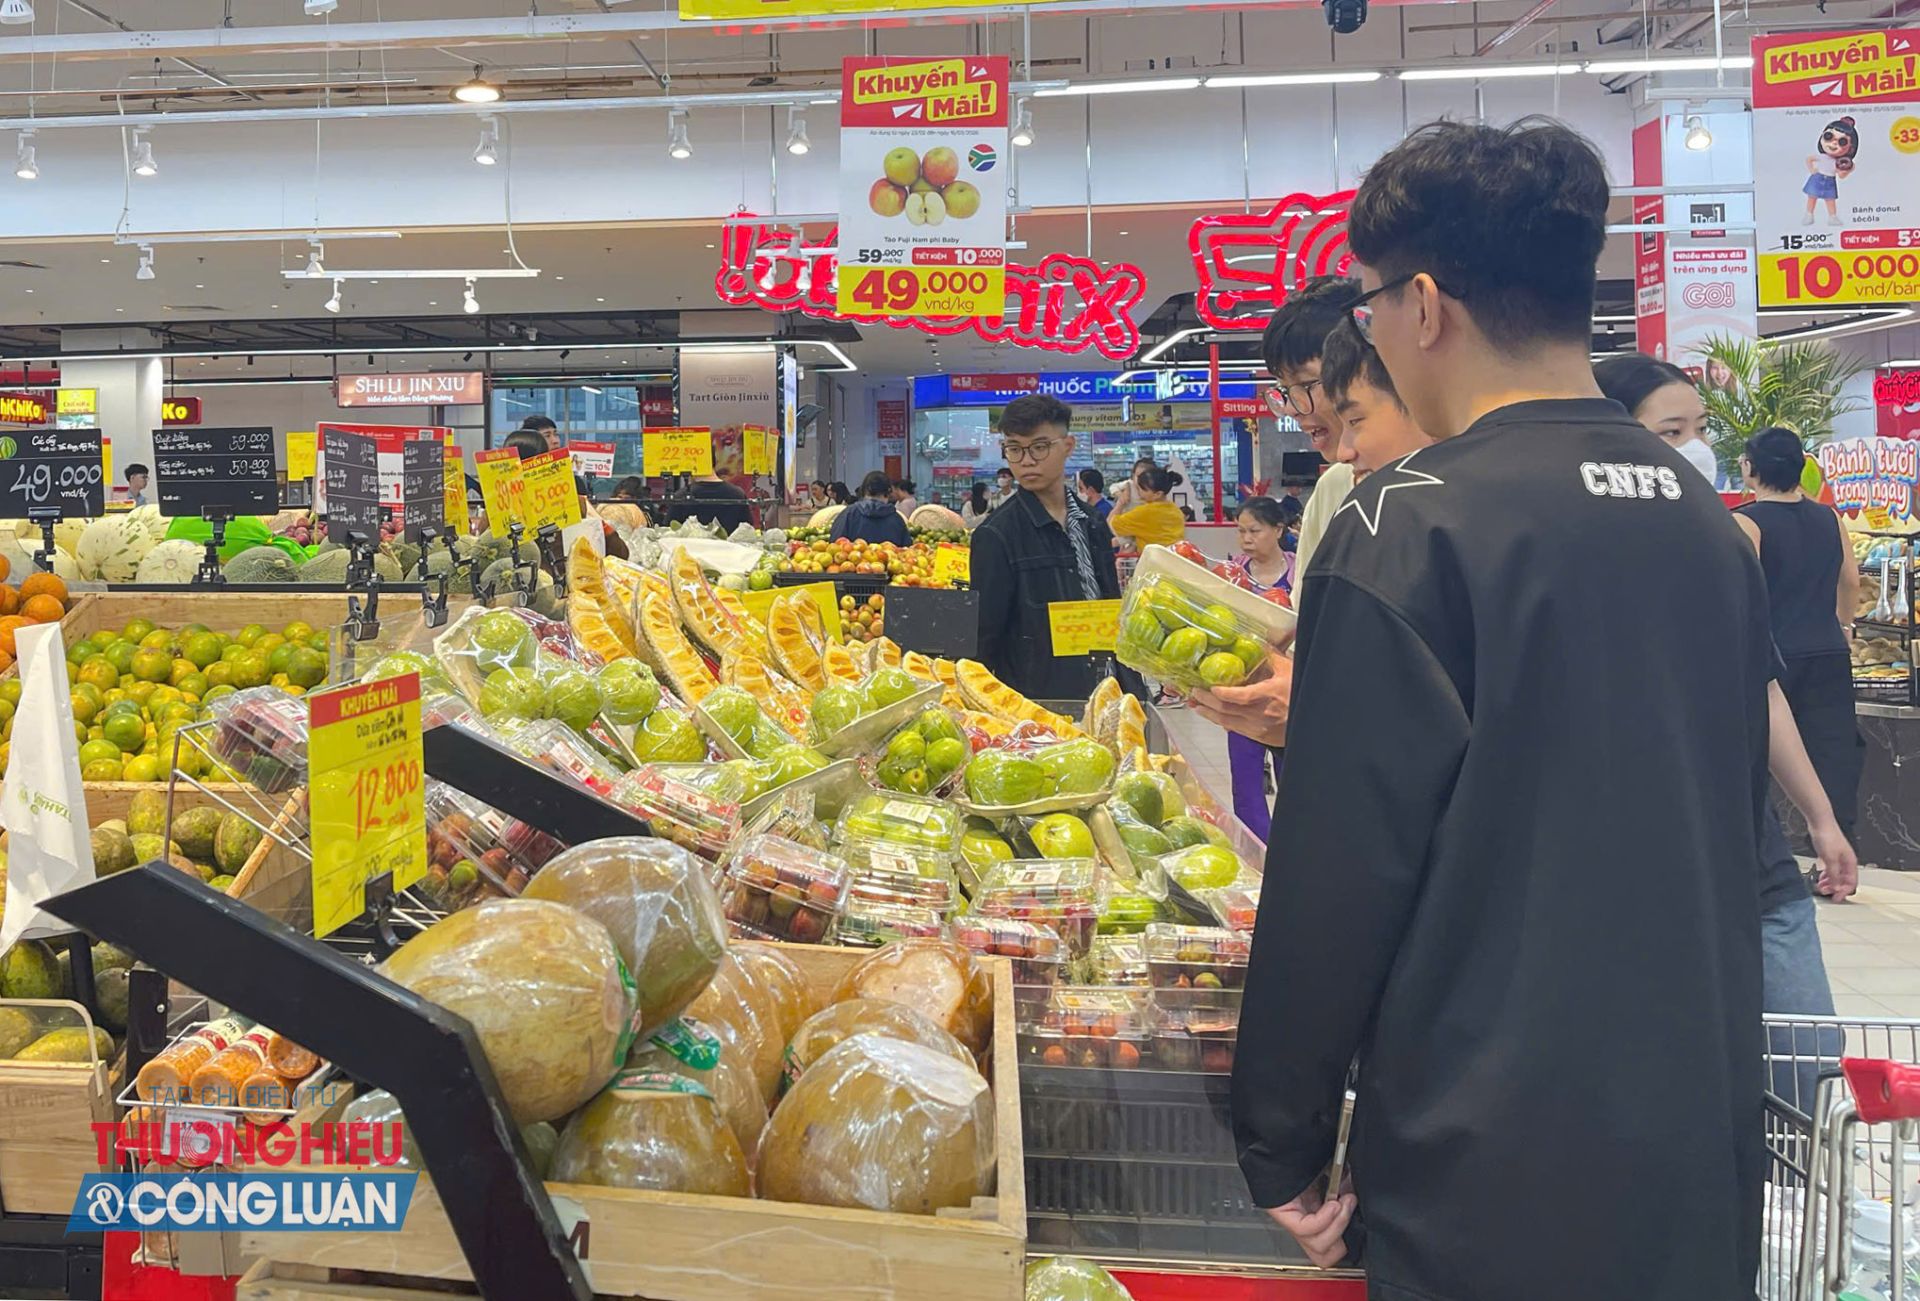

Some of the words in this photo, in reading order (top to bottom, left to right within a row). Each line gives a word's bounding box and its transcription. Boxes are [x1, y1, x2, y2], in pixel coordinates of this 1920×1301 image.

[1769, 39, 1880, 75] Khuyến
[858, 65, 959, 97] Khuyến
[1854, 56, 1917, 94] Mãi!
[933, 83, 992, 118] Mãi!
[1894, 127, 1920, 144] -33
[1852, 205, 1874, 214] Bánh
[1875, 205, 1900, 213] donut
[1852, 214, 1880, 223] sôcôla
[898, 236, 911, 244] Fuji
[929, 236, 940, 244] phi
[942, 236, 959, 244] Baby
[915, 252, 930, 261] TIẾT
[954, 248, 1003, 265] 10.000
[1676, 251, 1700, 260] Nhiều
[1702, 251, 1715, 259] mã
[1673, 265, 1695, 274] trên
[1698, 264, 1718, 274] ứng
[1721, 264, 1748, 274] dụng
[1777, 253, 1920, 300] 10.000
[851, 268, 989, 312] 49.000
[1683, 282, 1736, 309] GO!
[924, 297, 975, 313] vnd/kg
[355, 377, 384, 393] SHI
[408, 377, 433, 396] JIN
[436, 376, 465, 392] XIU
[688, 393, 711, 401] Tart
[712, 392, 736, 401] Giòn
[1038, 377, 1091, 394] THUỐC
[1223, 402, 1257, 415] Sitting
[1824, 440, 1872, 480] Bánh
[1876, 439, 1916, 478] tươi
[9, 463, 102, 502] 49.000
[1580, 462, 1682, 500] CNFS
[1833, 480, 1869, 508] trong
[1871, 478, 1909, 511] ngày
[340, 683, 380, 718] KHUYẾN
[381, 681, 398, 706] MÃI
